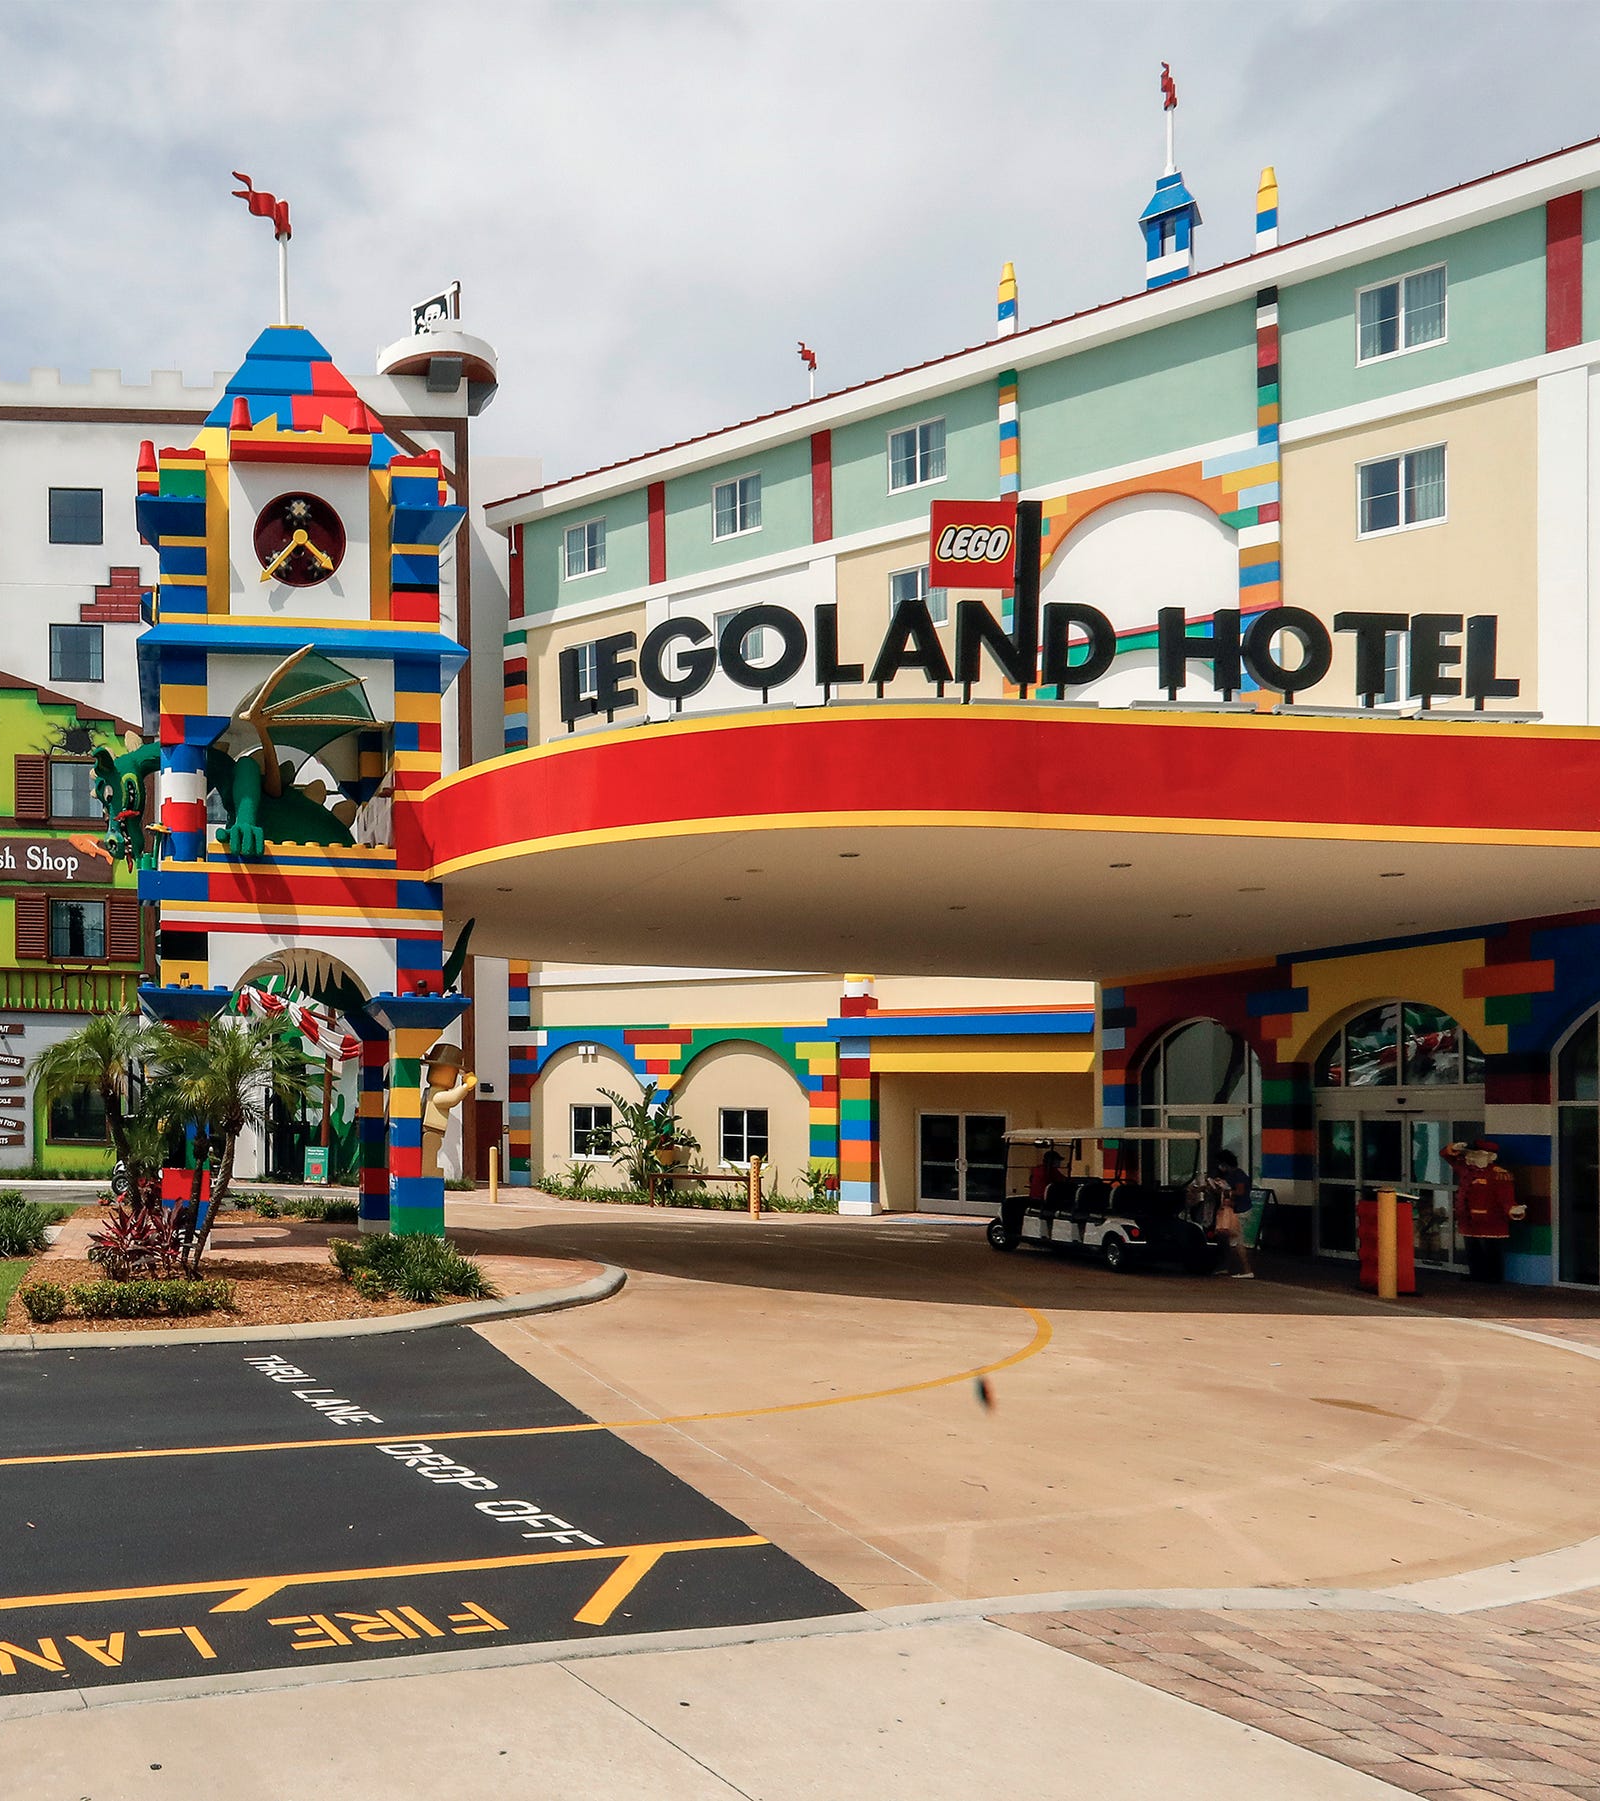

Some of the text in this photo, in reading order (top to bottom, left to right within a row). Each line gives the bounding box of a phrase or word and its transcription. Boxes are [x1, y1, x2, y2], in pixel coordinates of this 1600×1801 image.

[937, 526, 1010, 561] LEGO
[559, 599, 1520, 723] LEGOLAND HOTEL
[26, 846, 79, 879] Shop
[3, 1119, 17, 1128] FISH
[244, 1354, 384, 1426] THRU LANE
[375, 1443, 605, 1546] DROP OFF
[269, 1602, 510, 1651] FIRE
